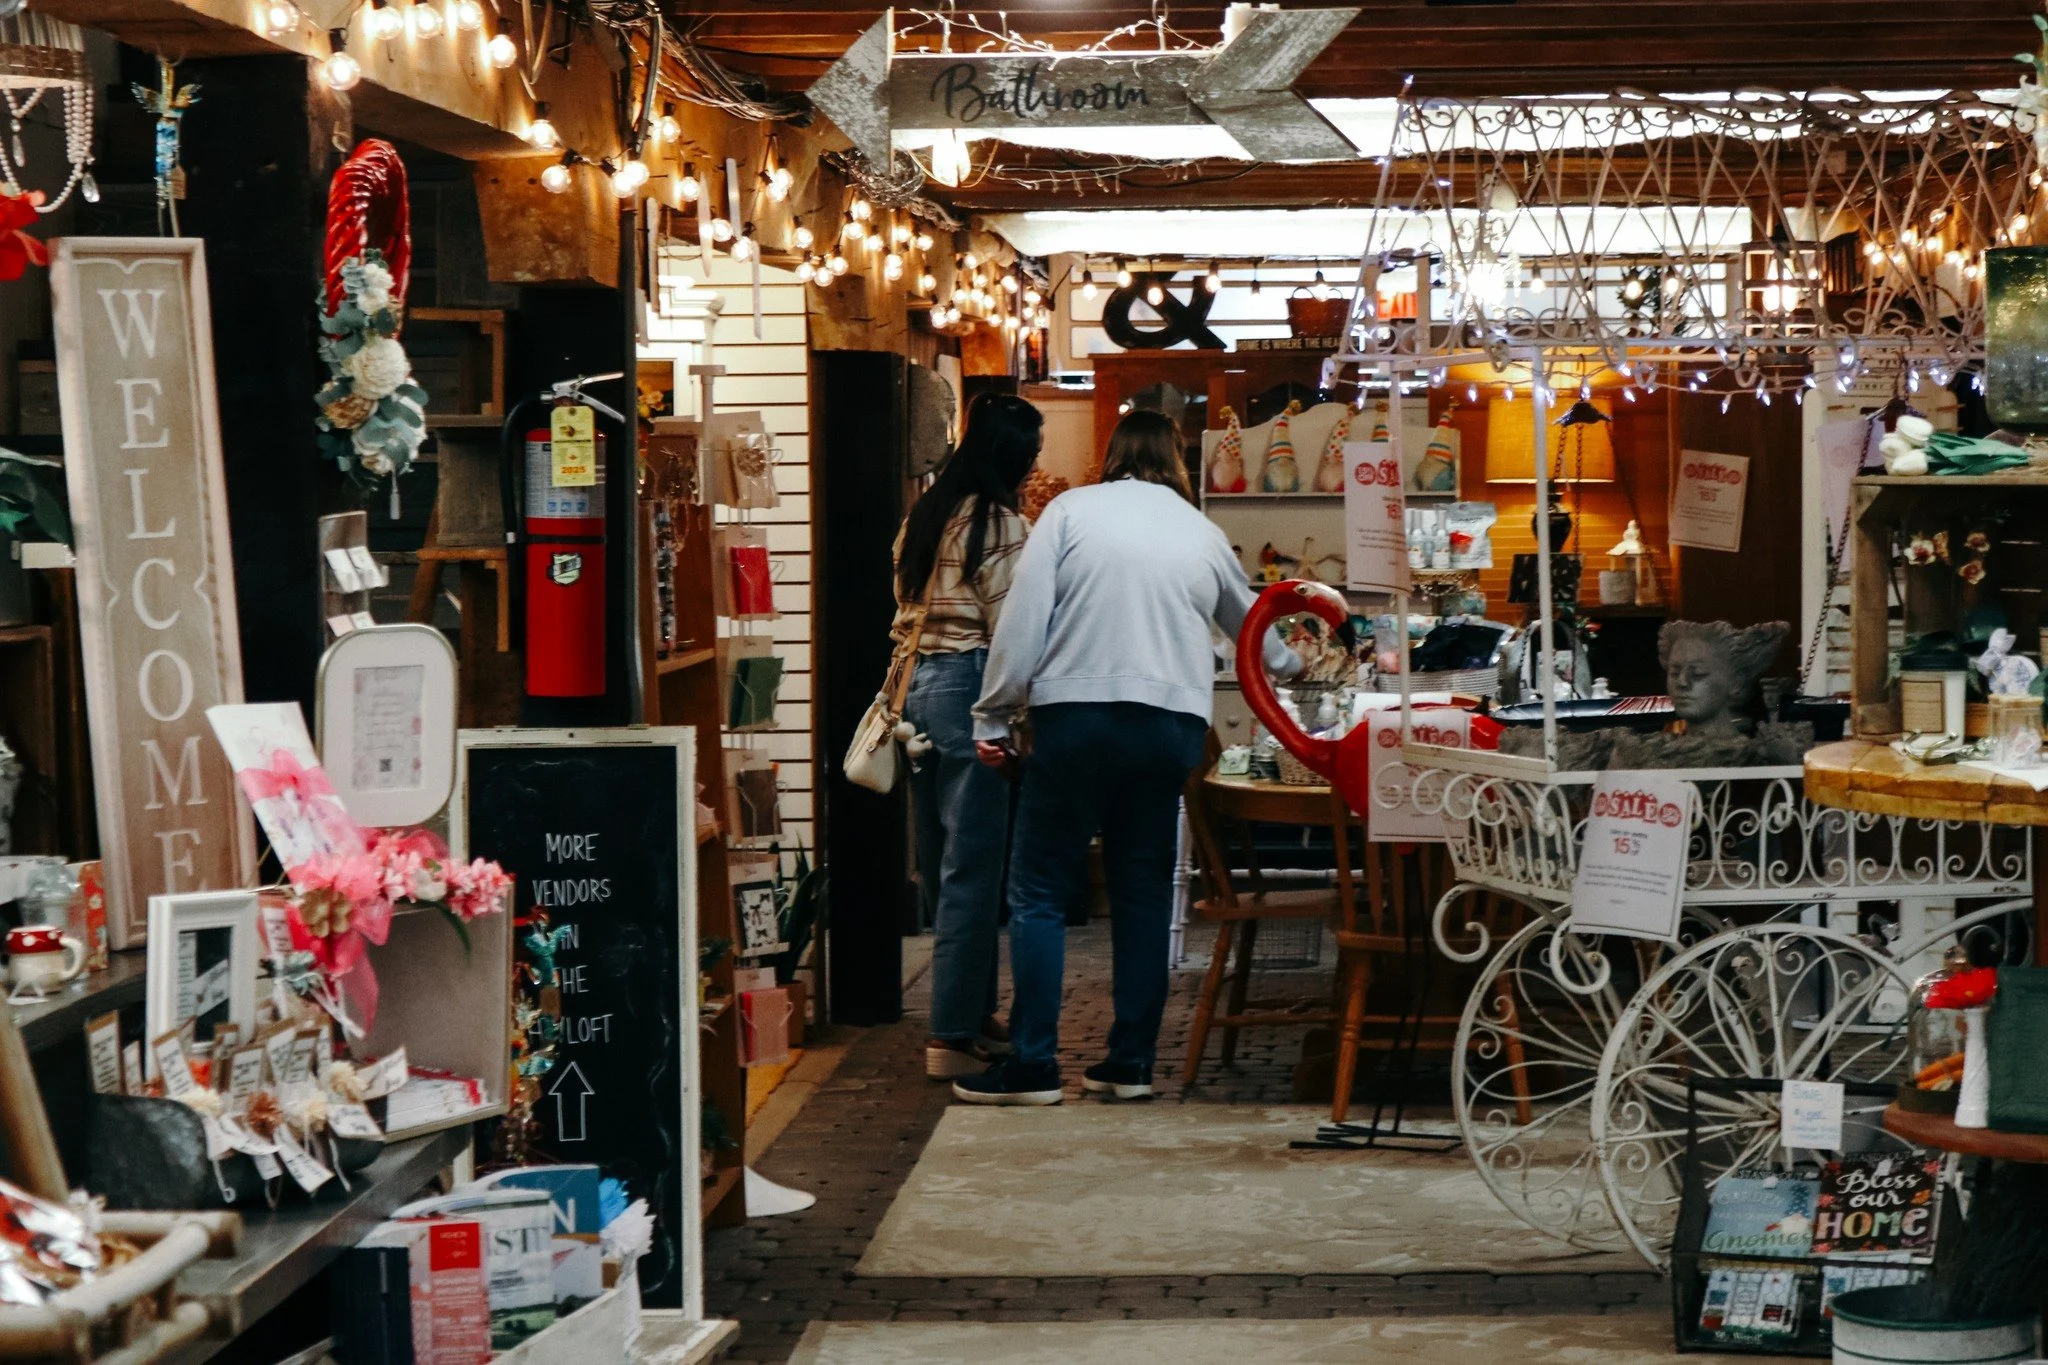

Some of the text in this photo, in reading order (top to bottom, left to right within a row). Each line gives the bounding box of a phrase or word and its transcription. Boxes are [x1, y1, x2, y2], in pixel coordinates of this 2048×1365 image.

[930, 62, 1150, 123] Bathroom
[1378, 291, 1418, 317] EXIT
[1237, 340, 1260, 351] HOME
[1261, 340, 1271, 350] IS
[1273, 338, 1302, 350] WHERE
[1305, 338, 1321, 348] THE
[96, 288, 208, 895] WELCOME
[1608, 792, 1658, 822] SALE
[546, 832, 601, 864] MORE
[1613, 837, 1631, 855] 15
[532, 878, 612, 907] VENDORS
[1835, 1168, 1923, 1195] Bless
[1849, 1189, 1906, 1209] our
